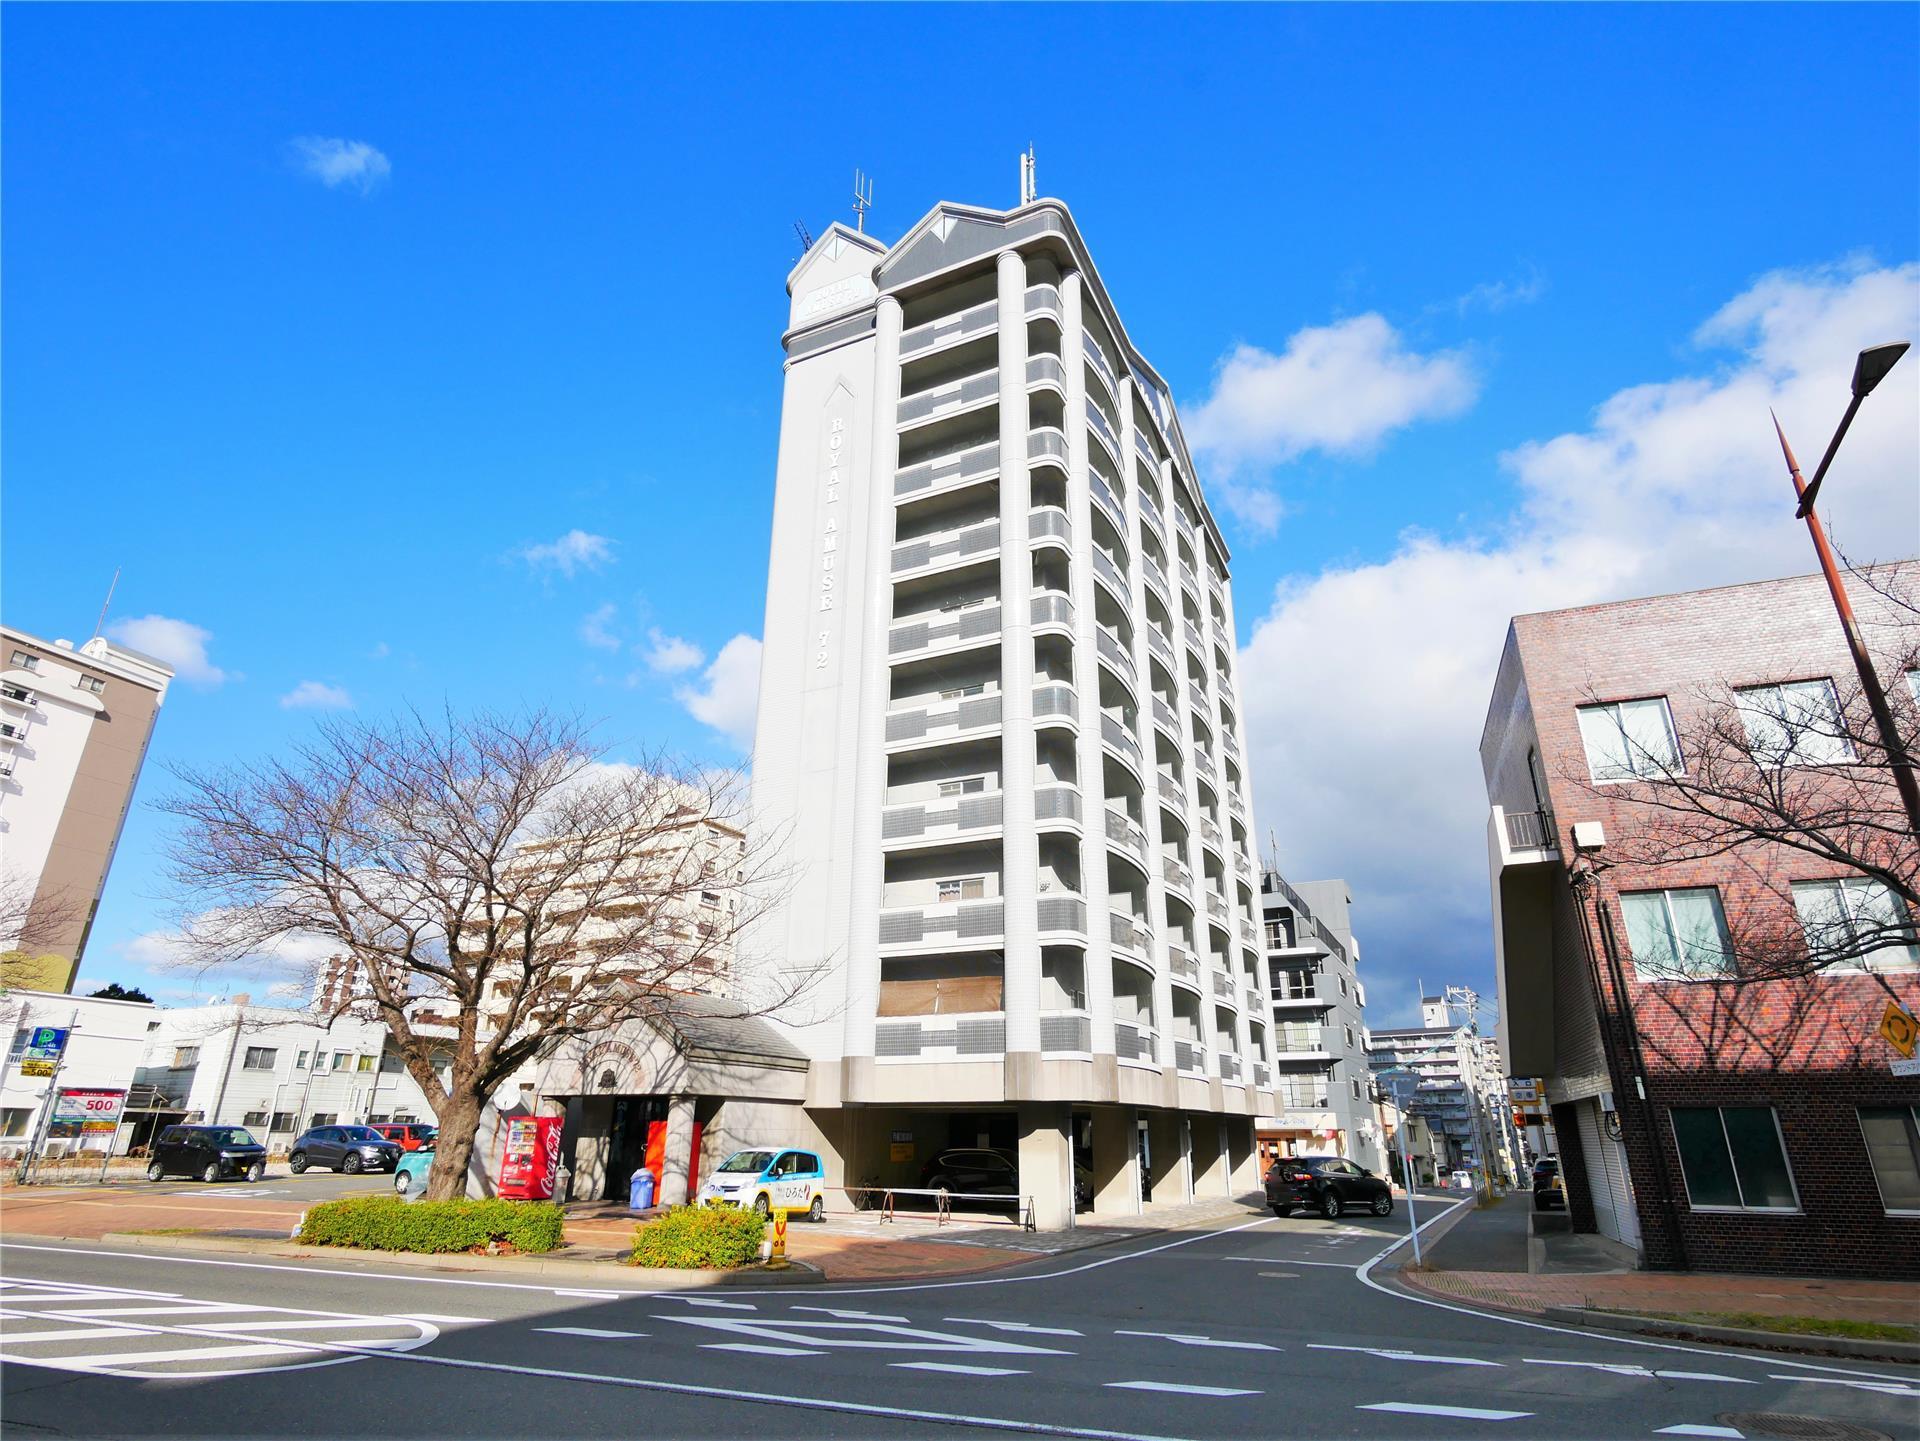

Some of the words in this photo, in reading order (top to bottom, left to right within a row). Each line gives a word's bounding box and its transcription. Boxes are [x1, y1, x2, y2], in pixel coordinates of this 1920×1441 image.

[827, 417, 844, 502] ROYAL
[820, 517, 838, 612] AMUSE
[37, 1028, 55, 1047] P
[86, 1100, 113, 1110] 500
